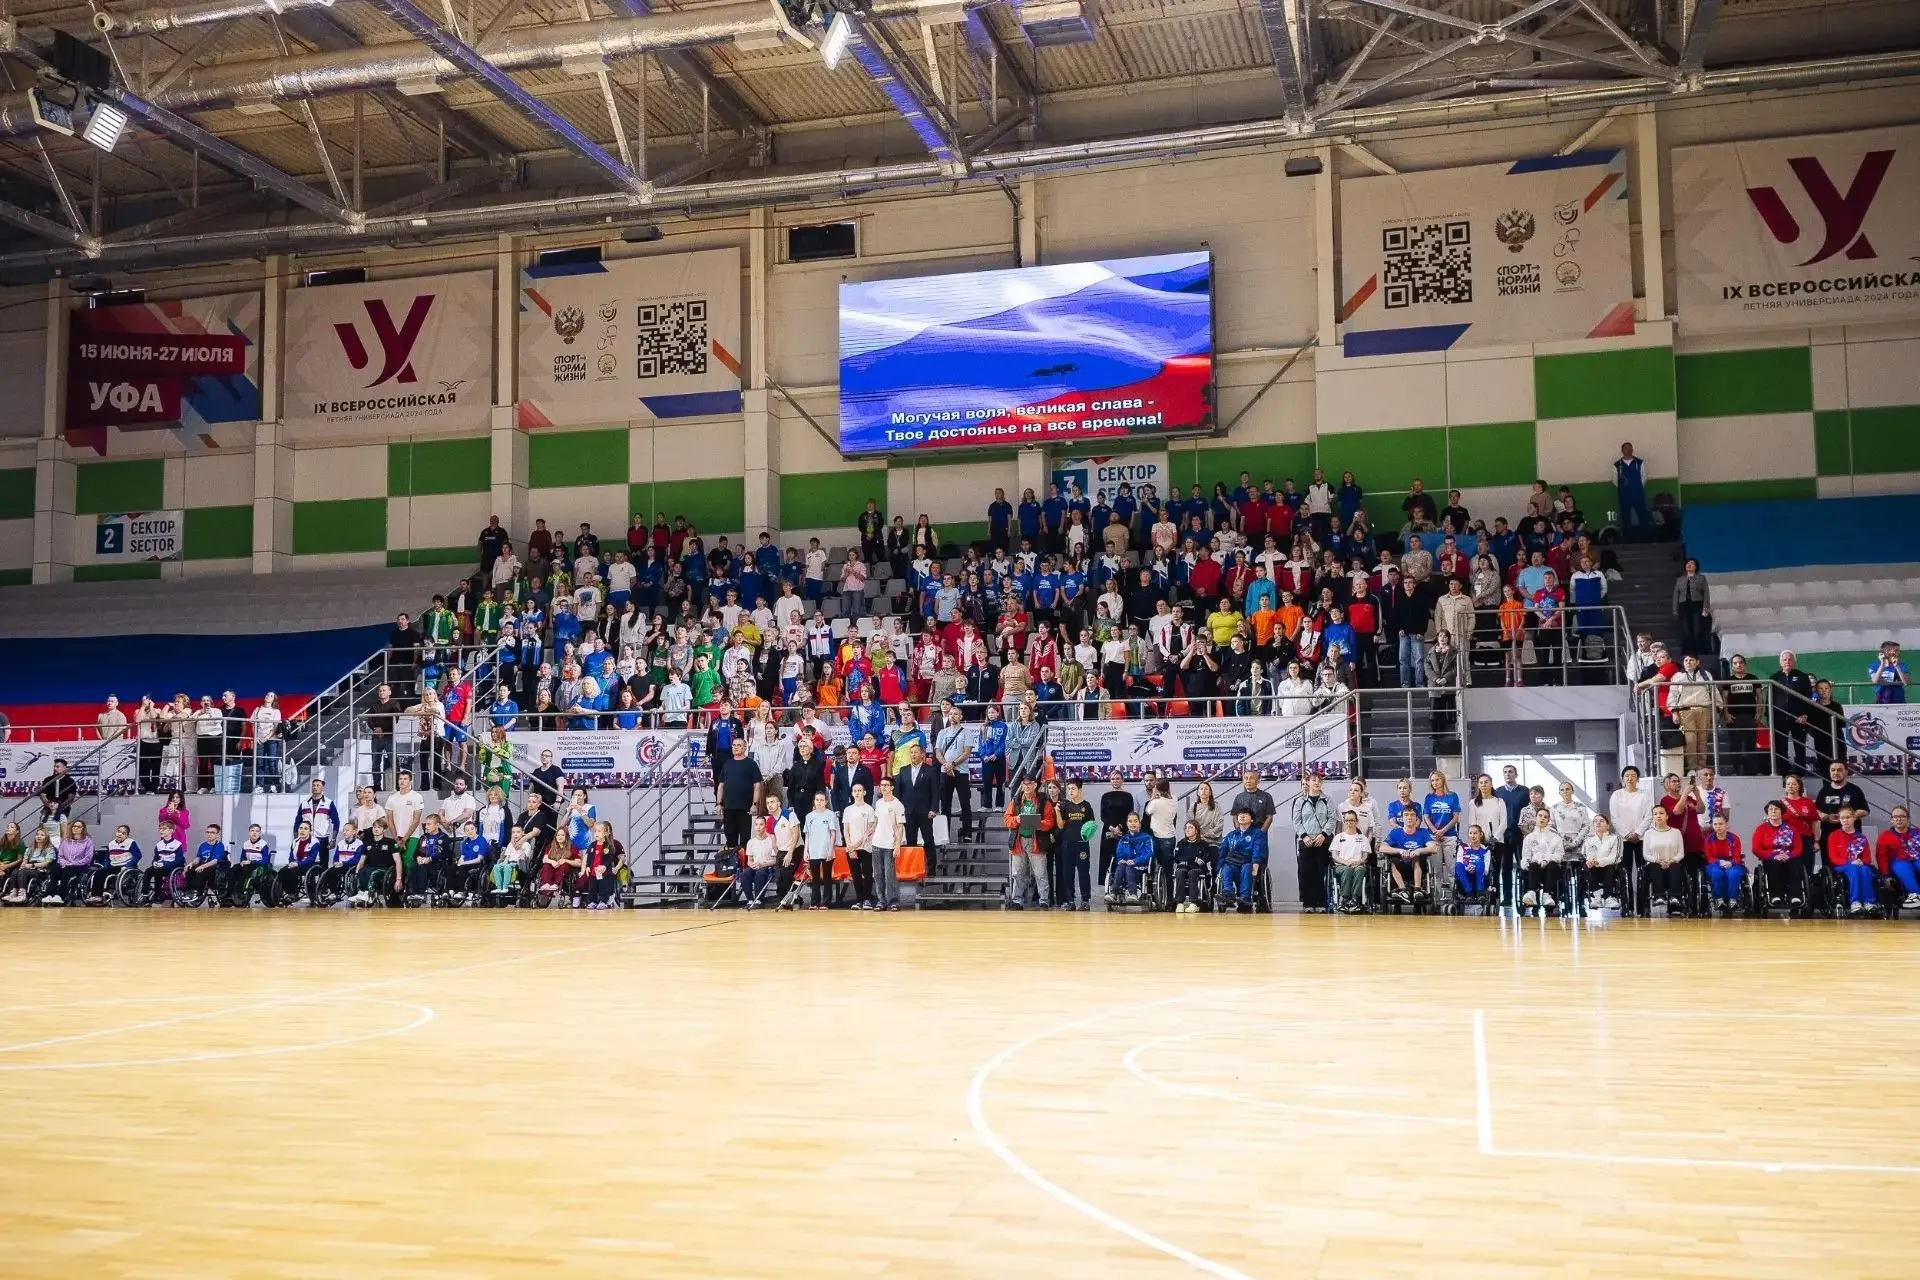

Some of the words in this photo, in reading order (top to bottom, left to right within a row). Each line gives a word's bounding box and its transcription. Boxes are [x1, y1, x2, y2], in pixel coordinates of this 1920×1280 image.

[1496, 264, 1532, 276] СПОРТ
[1498, 274, 1540, 286] НОРМА
[1498, 284, 1540, 296] ЖИЗНИ
[1723, 286, 1743, 300] IX
[1743, 301, 1782, 311] ЛЕТНЯЯ
[1786, 294, 1861, 308] УНИВЕРСИАДА
[1864, 293, 1888, 301] 2024
[1891, 290, 1919, 300] ГОДА
[80, 344, 98, 358] 15
[100, 345, 178, 361] ИЮНЯ-27
[182, 347, 233, 362] ИЮЛЯ
[554, 354, 580, 364] СПОРТ
[554, 363, 586, 373] НОРМА
[554, 372, 586, 382] ЖИЗНИ
[88, 382, 164, 412] УФА
[314, 402, 327, 414] IX
[331, 392, 456, 412] ВСЕРОССИЙСКАЯ
[354, 412, 404, 422] УНИВЕРСИАДА
[424, 408, 443, 416] ГОДА
[892, 410, 960, 426] Могучая
[966, 408, 1012, 420] воля,
[1016, 401, 1086, 416] великая
[1090, 398, 1143, 411] слава
[885, 429, 924, 442] Твое
[928, 424, 1016, 440] достоянье
[1022, 422, 1042, 432] на
[1048, 420, 1077, 431] все
[1082, 412, 1163, 431] времена!
[1098, 464, 1157, 482] СЕКТОР
[1063, 476, 1075, 500] 3
[130, 520, 175, 535] СЕКТОР
[104, 528, 114, 548] 2
[130, 538, 174, 553] SECTOR
